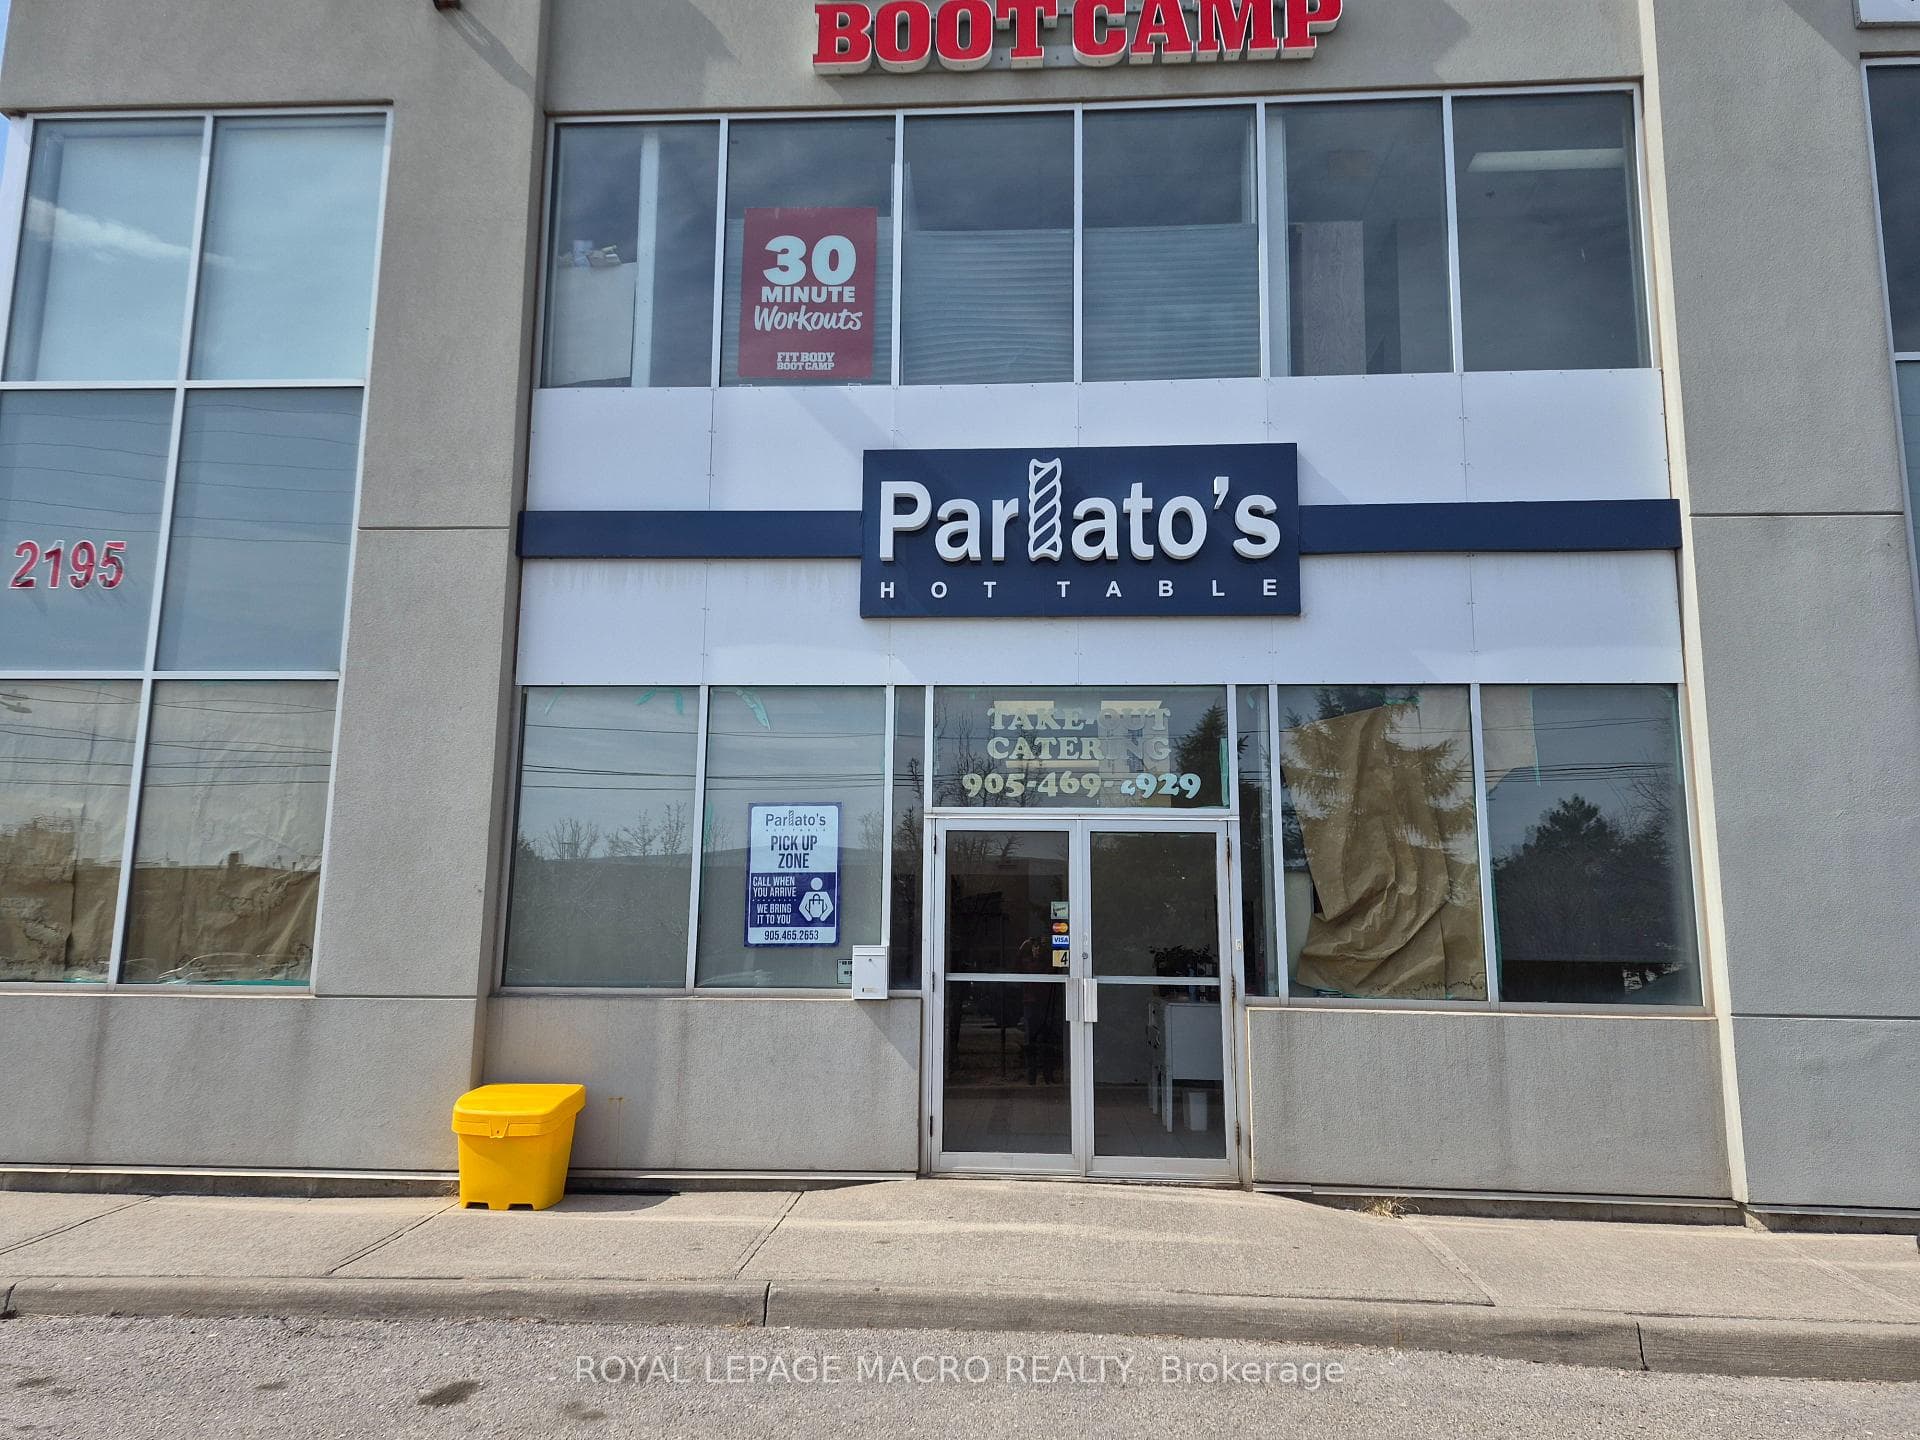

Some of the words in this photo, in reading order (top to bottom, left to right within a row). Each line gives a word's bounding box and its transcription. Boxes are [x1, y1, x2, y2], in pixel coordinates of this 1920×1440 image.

[812, 0, 1059, 72] BOOT
[1072, 0, 1343, 66] CAMP
[762, 234, 857, 286] 30
[761, 286, 856, 303] MINUTE
[754, 305, 863, 332] Workouts
[777, 352, 800, 362] FIT
[800, 352, 835, 362] BODY
[777, 362, 805, 371] BOOT
[805, 362, 835, 371] CAMP
[880, 457, 1281, 563] Parlato's
[8, 539, 128, 590] 2195
[880, 581, 997, 599] HOT
[1056, 578, 1278, 599] TABLE
[987, 707, 1171, 731] TAKE-OUT
[986, 736, 1172, 760] CATERING
[765, 809, 826, 827] Parlato's
[770, 835, 799, 851] PICK
[801, 835, 818, 851] UP
[778, 853, 810, 869] ZONE
[752, 876, 771, 887] CALL
[773, 876, 795, 887] WHEN
[753, 887, 768, 897] YOU
[769, 886, 797, 897] ARRIVE
[756, 903, 768, 914] WE
[769, 903, 792, 914] BRING
[757, 914, 765, 925] IT
[766, 914, 775, 924] TO
[776, 914, 791, 924] YOU
[764, 930, 819, 941] 905.465.2653
